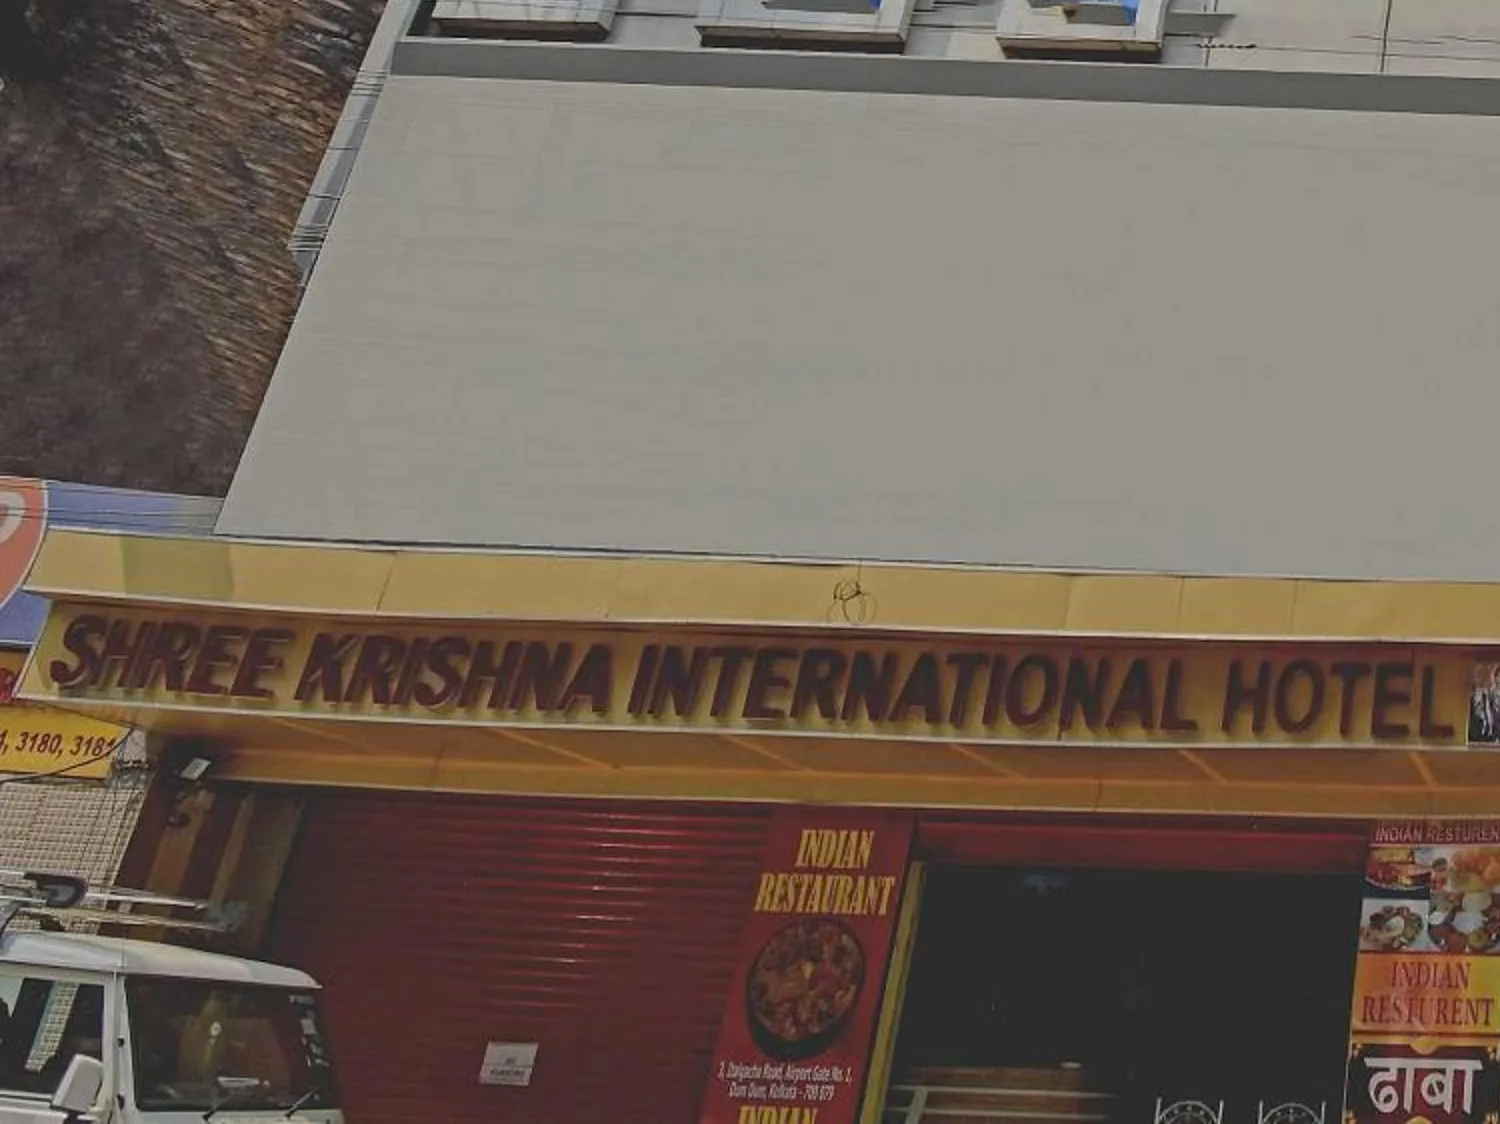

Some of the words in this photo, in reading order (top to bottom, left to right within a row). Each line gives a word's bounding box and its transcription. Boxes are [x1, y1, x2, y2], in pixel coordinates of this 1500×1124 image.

[50, 614, 296, 697] SHREE
[295, 632, 611, 714] KRISHNA
[628, 645, 1198, 734] INTERNATIONAL
[1221, 661, 1454, 740] HOTEL
[15, 731, 63, 758] 3180,
[794, 829, 875, 869] INDIAN
[1375, 824, 1423, 843] INDIAN
[754, 872, 895, 916] RESTAURANT
[1391, 960, 1471, 989] INDIAN
[1362, 996, 1495, 1026] RESTURENT
[1364, 1057, 1484, 1116] ढाबा
